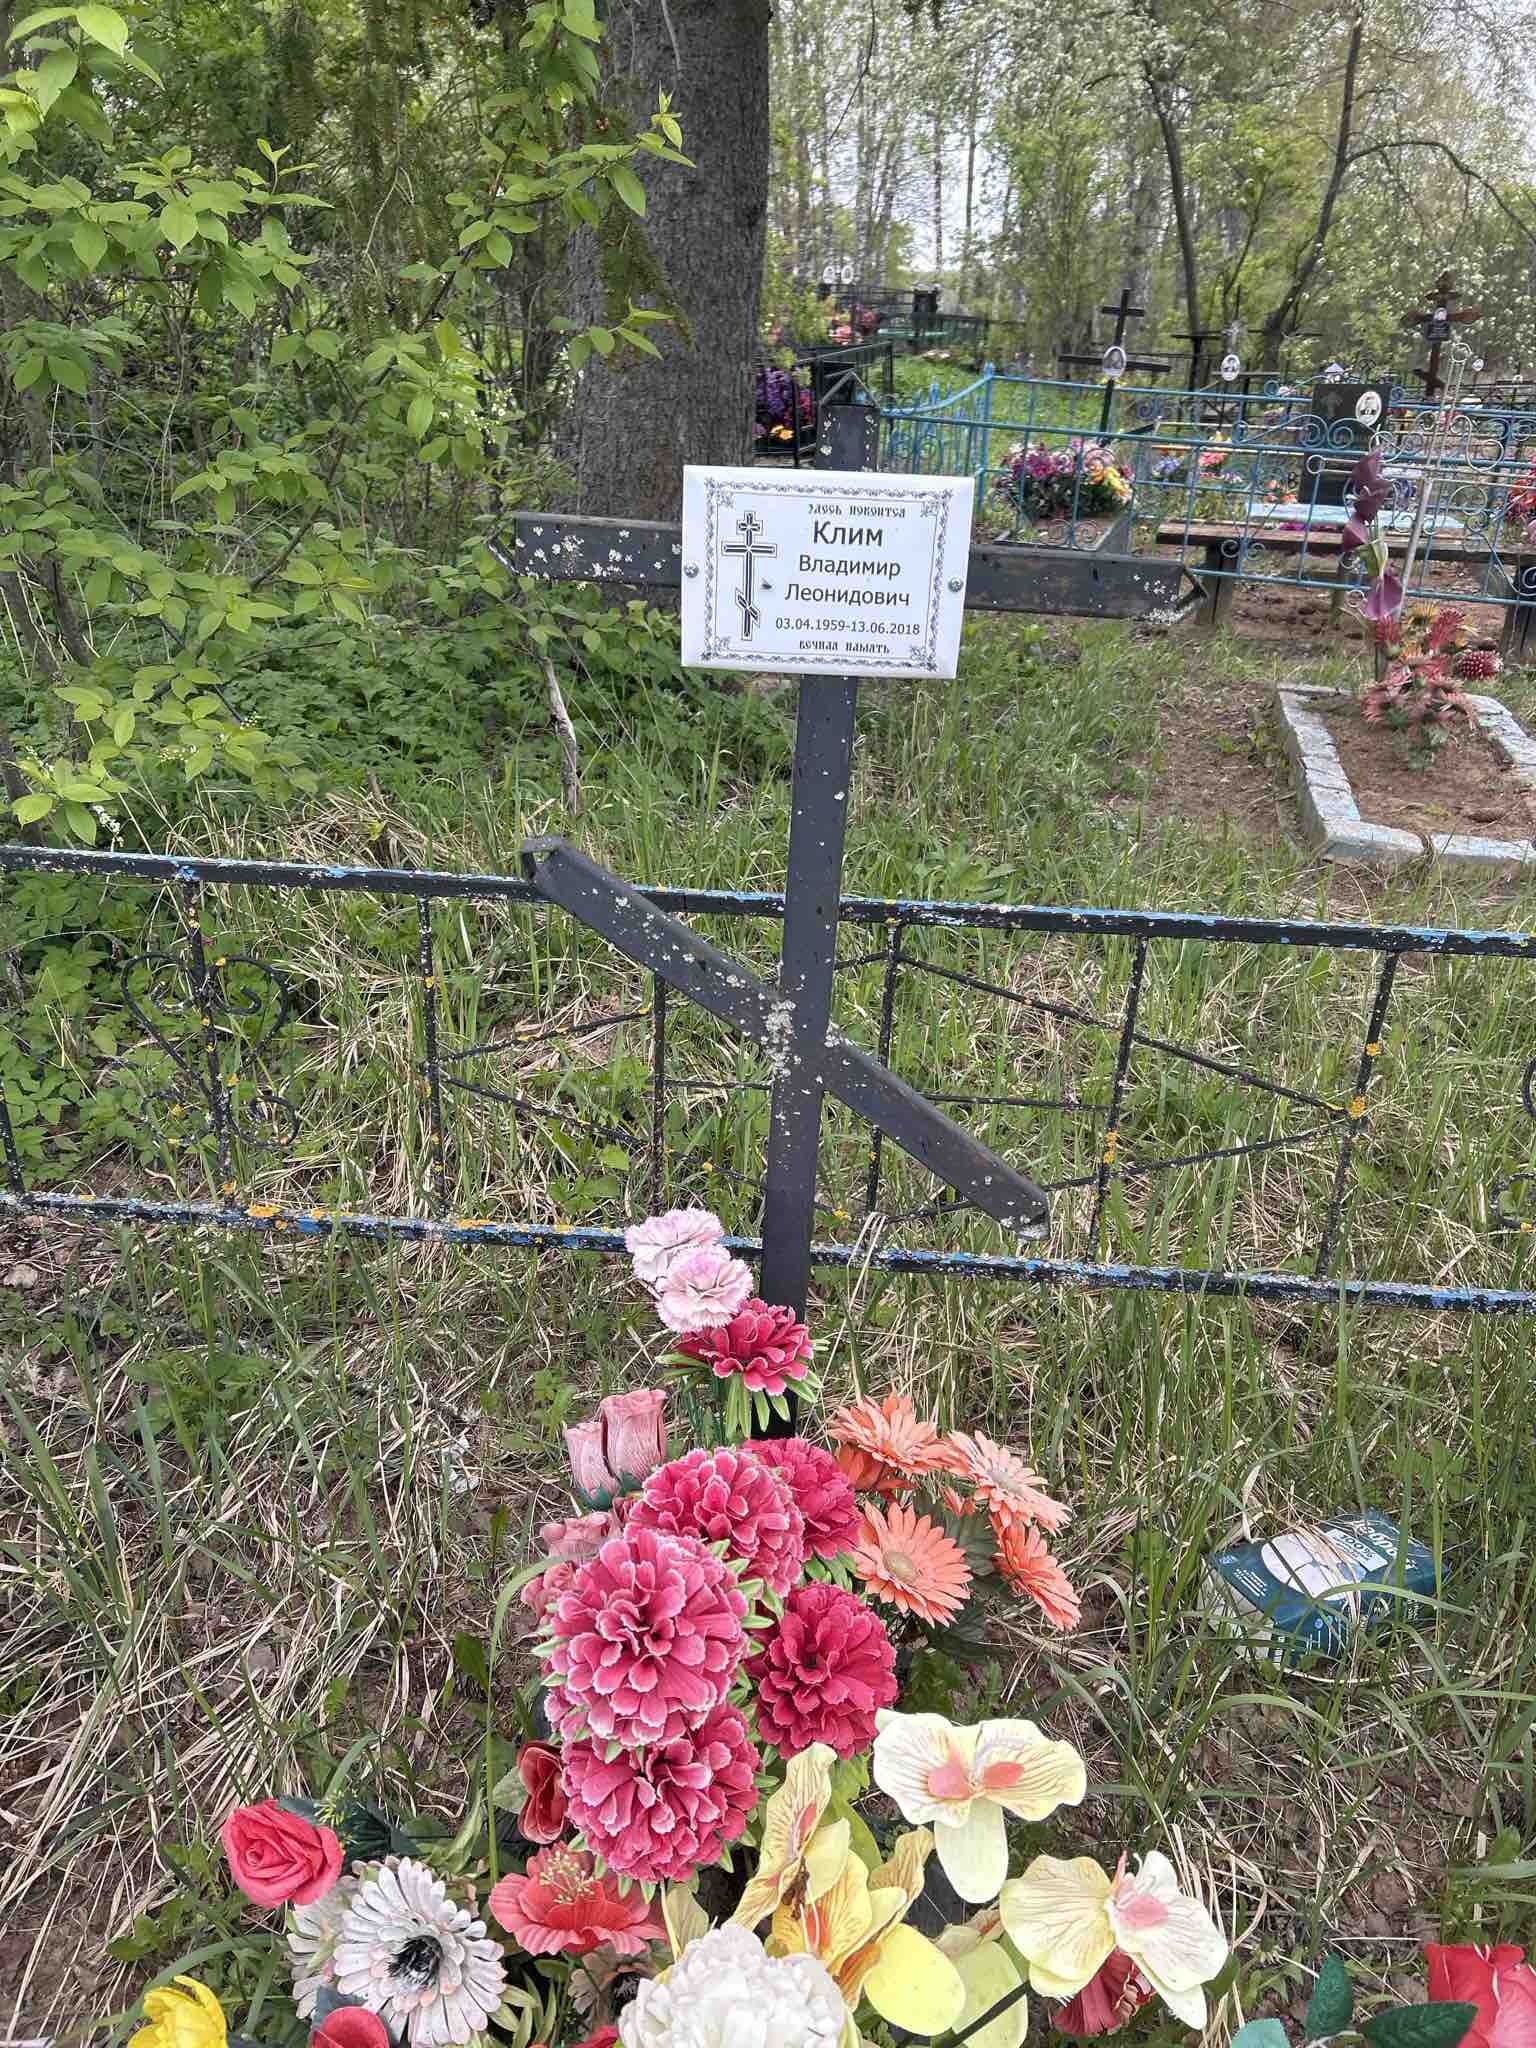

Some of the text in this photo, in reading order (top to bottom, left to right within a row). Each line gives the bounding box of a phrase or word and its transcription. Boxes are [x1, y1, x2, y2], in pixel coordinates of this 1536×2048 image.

[813, 519, 883, 547] Клим
[799, 553, 901, 581] Владимир
[784, 583, 911, 607] Леонидович
[775, 617, 921, 635] 03.04.1959-13.06.2018
